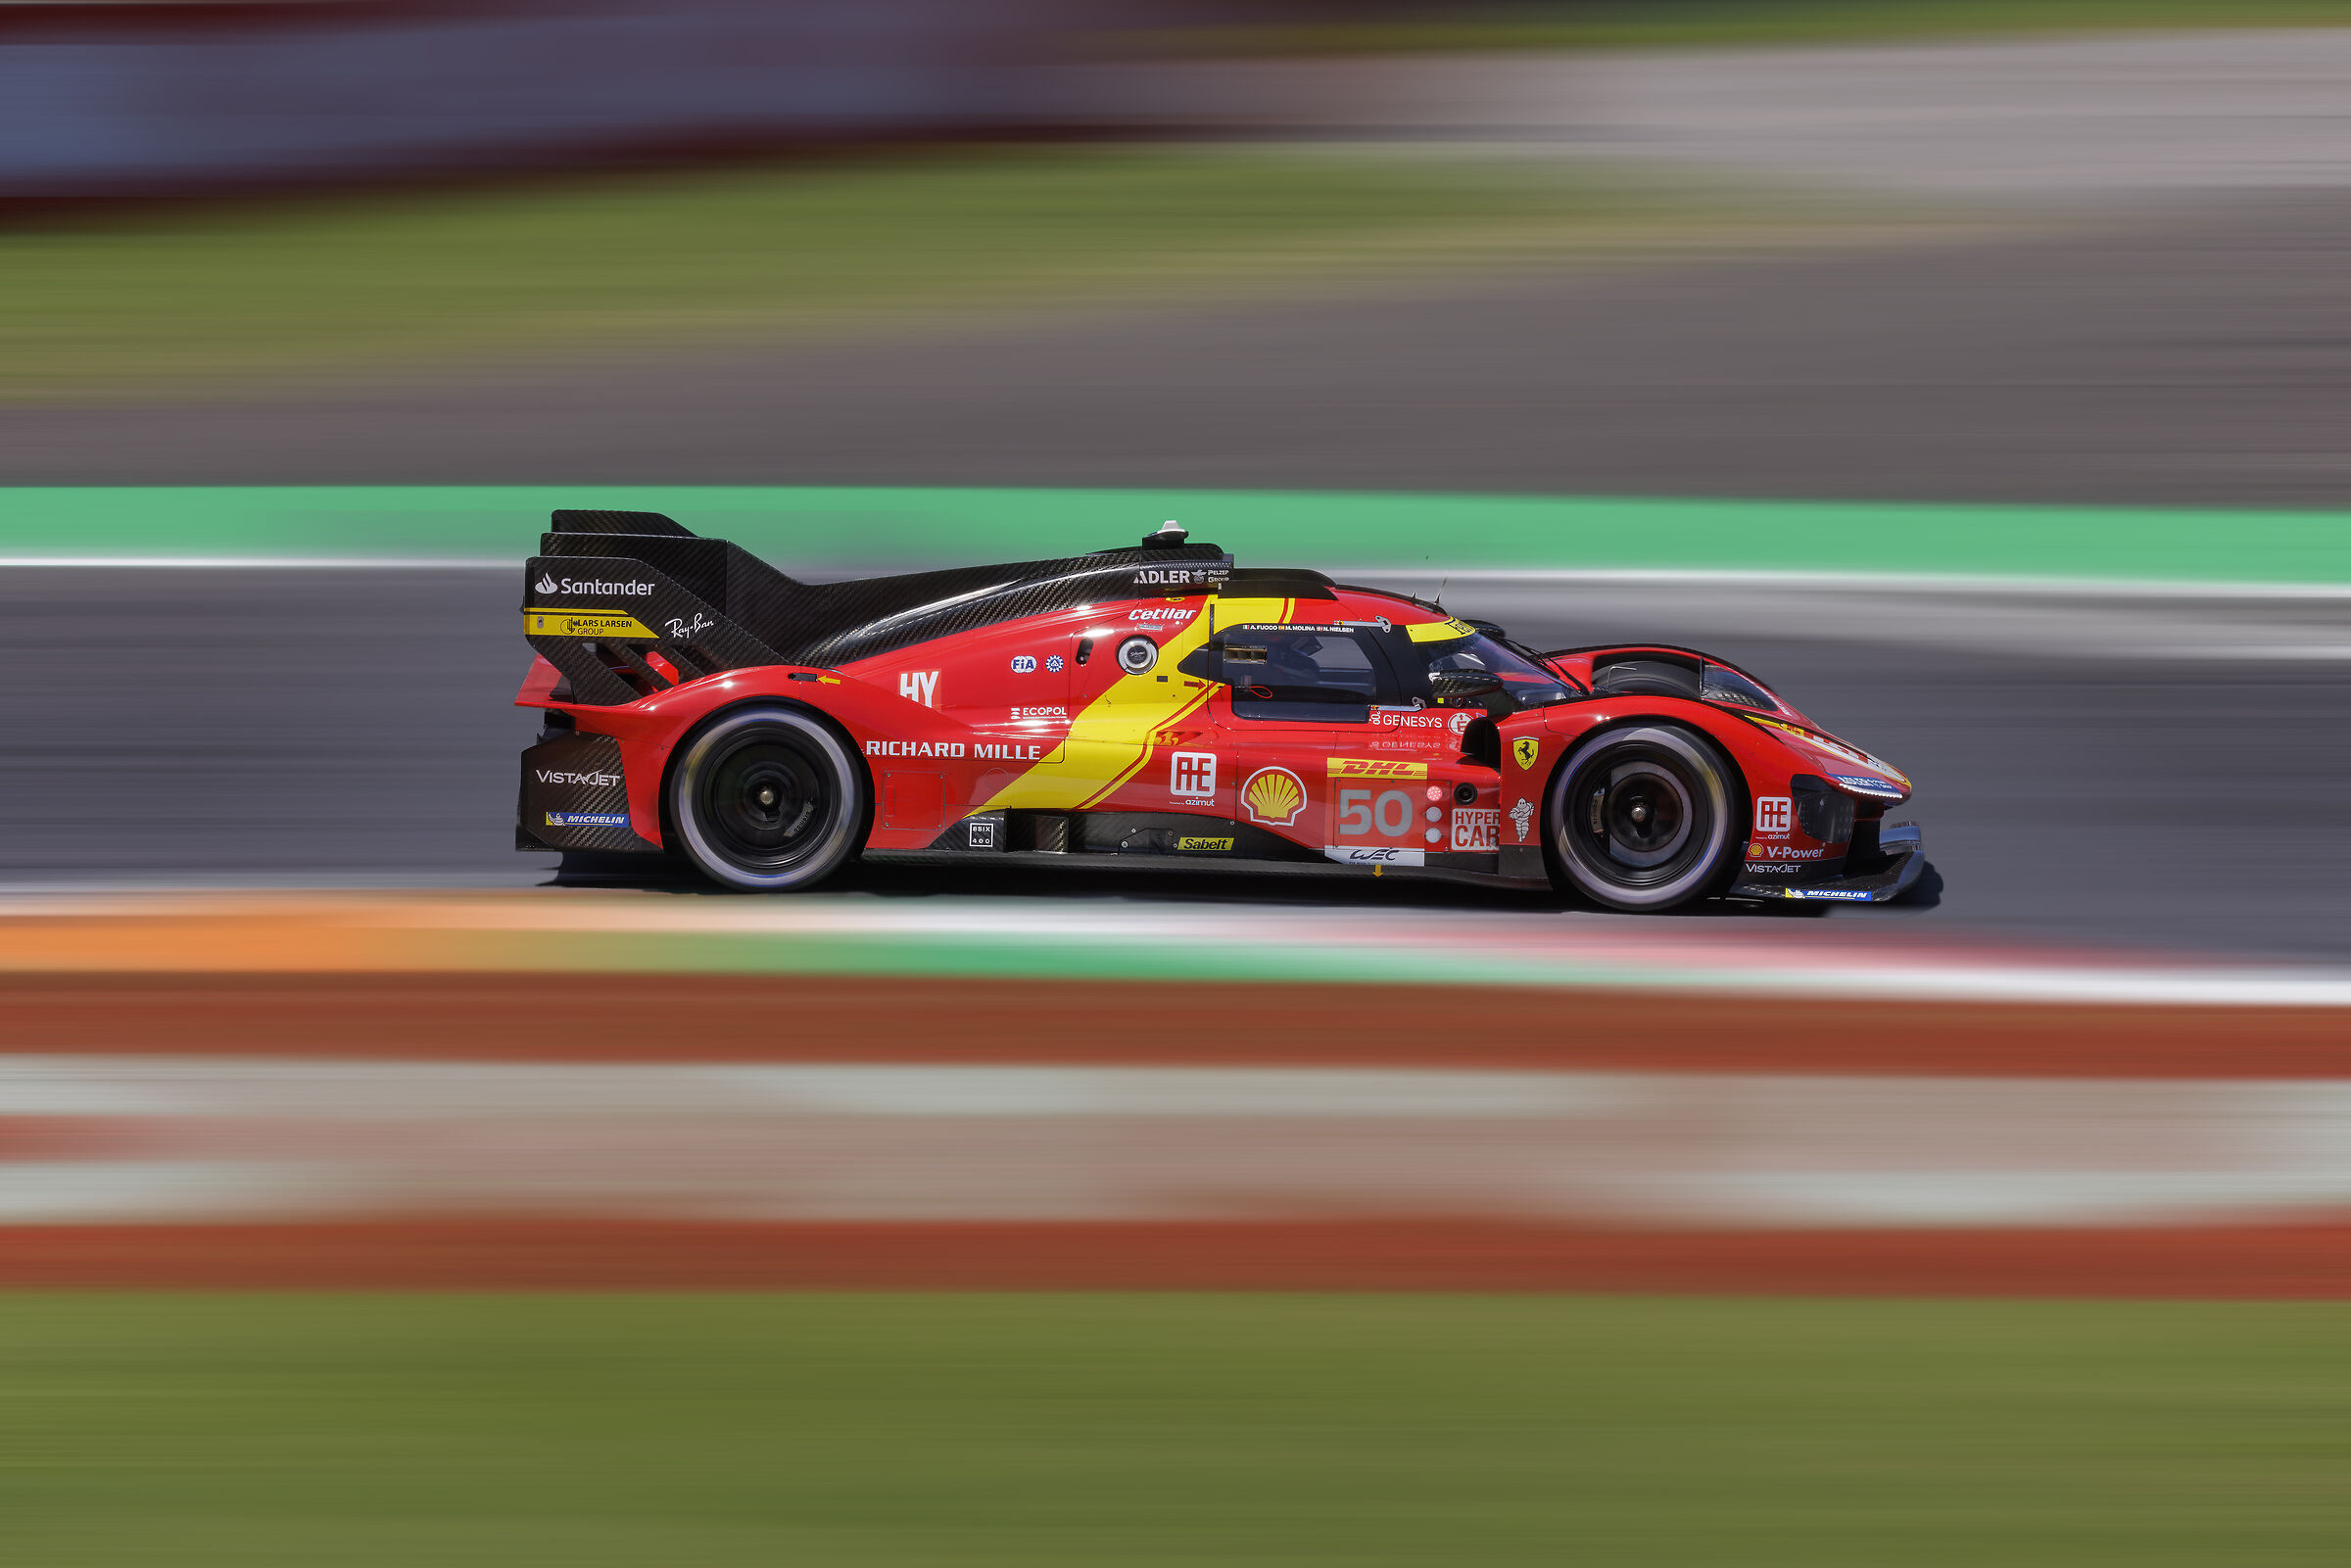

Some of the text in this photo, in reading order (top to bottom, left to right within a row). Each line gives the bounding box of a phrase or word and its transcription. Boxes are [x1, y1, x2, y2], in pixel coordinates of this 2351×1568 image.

[1133, 570, 1190, 584] ADLER
[560, 578, 655, 595] Santander
[600, 619, 632, 628] LARSEN
[664, 612, 714, 639] Ray-Ban
[899, 671, 939, 708] HY
[1023, 707, 1067, 716] ECOPOL
[1383, 715, 1443, 729] GENESYS
[866, 740, 1041, 760] RICHARD MILLE
[1340, 760, 1416, 776] DHL
[1185, 796, 1215, 807] azimut
[567, 815, 625, 824] MICHELIN
[1338, 788, 1414, 837] 50
[1455, 811, 1501, 825] HYPER
[1455, 825, 1501, 847] CAR
[1767, 832, 1791, 840] azimut
[1183, 838, 1226, 850] Sabelt
[1350, 848, 1400, 861] WEC
[1767, 845, 1824, 859] V-Power
